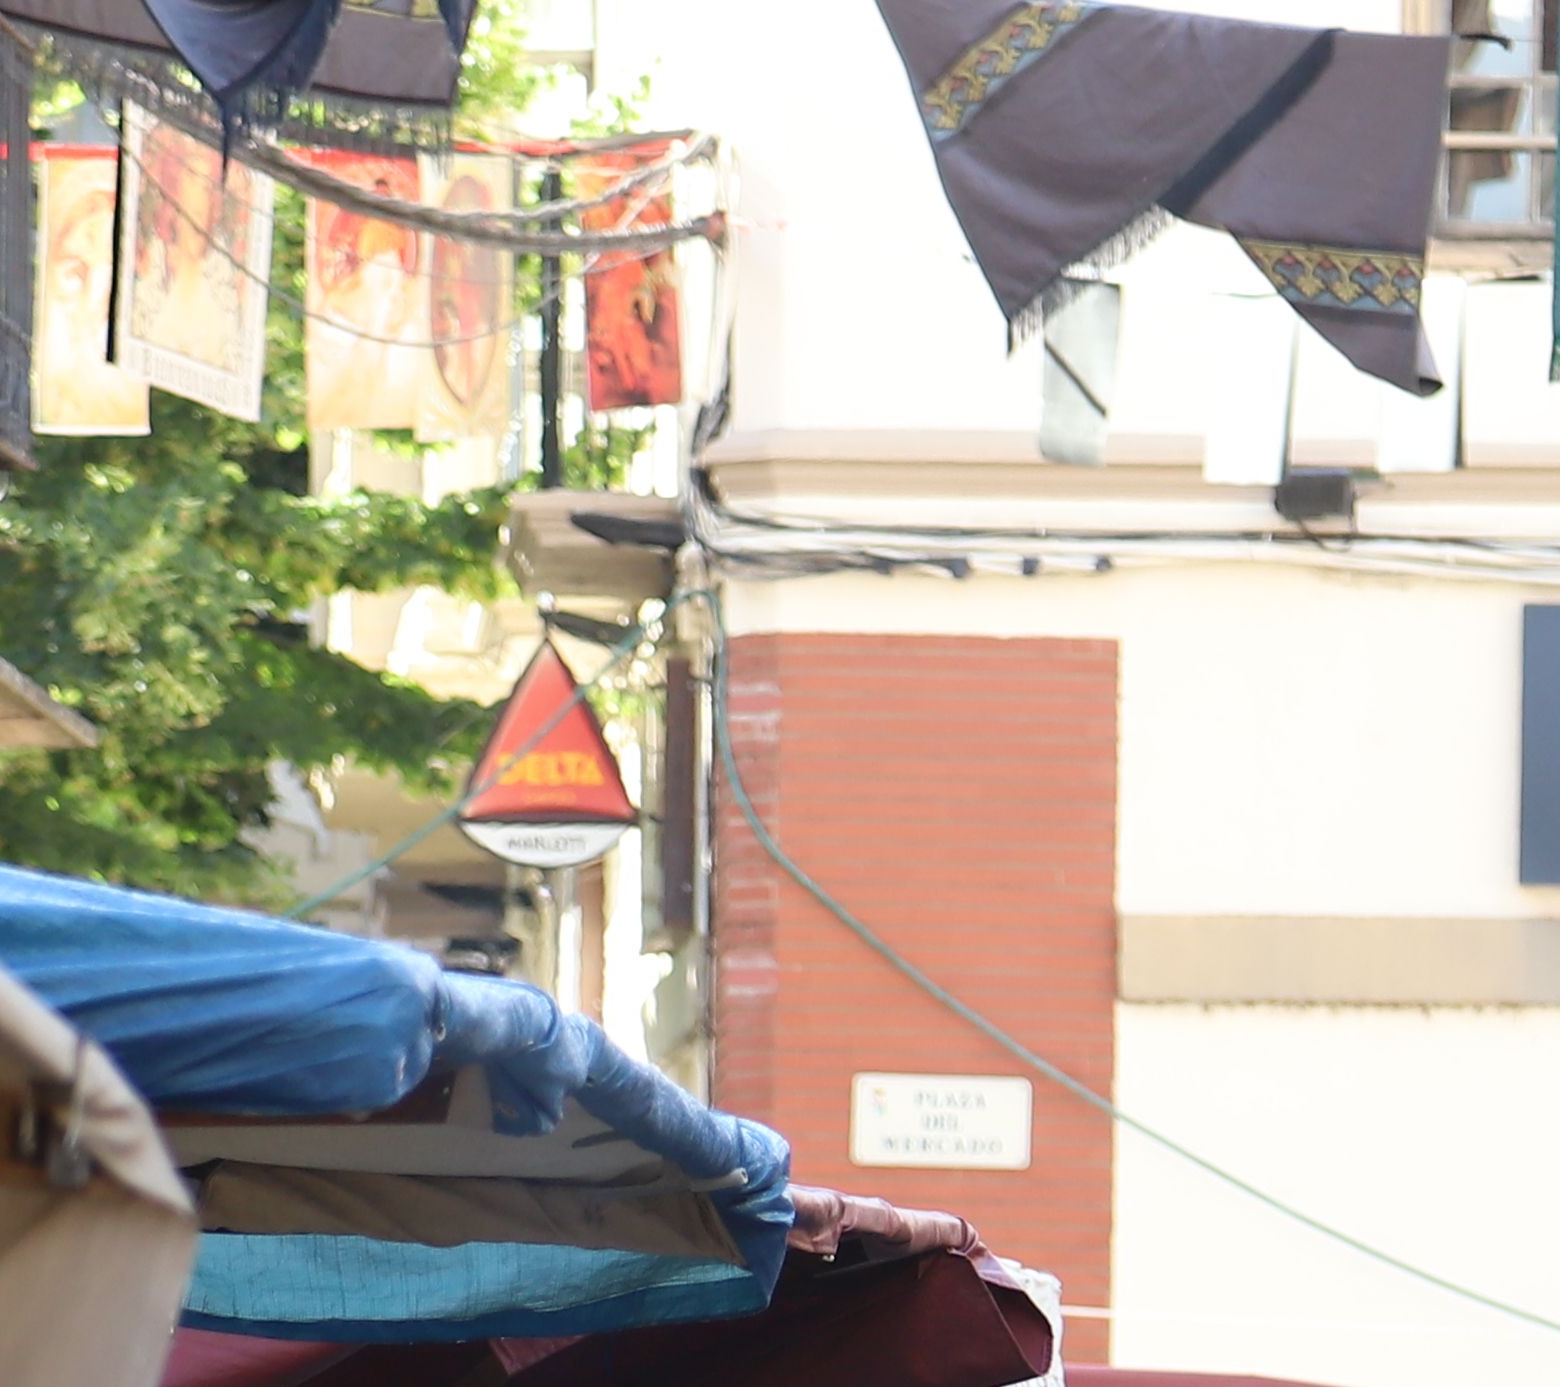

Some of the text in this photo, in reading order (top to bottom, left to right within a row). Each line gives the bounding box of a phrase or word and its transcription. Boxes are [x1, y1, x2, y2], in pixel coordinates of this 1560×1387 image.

[497, 750, 605, 787] DELTA
[913, 1090, 987, 1110] PLAZA
[920, 1113, 963, 1131] DEL
[883, 1137, 1003, 1155] MERCADO
